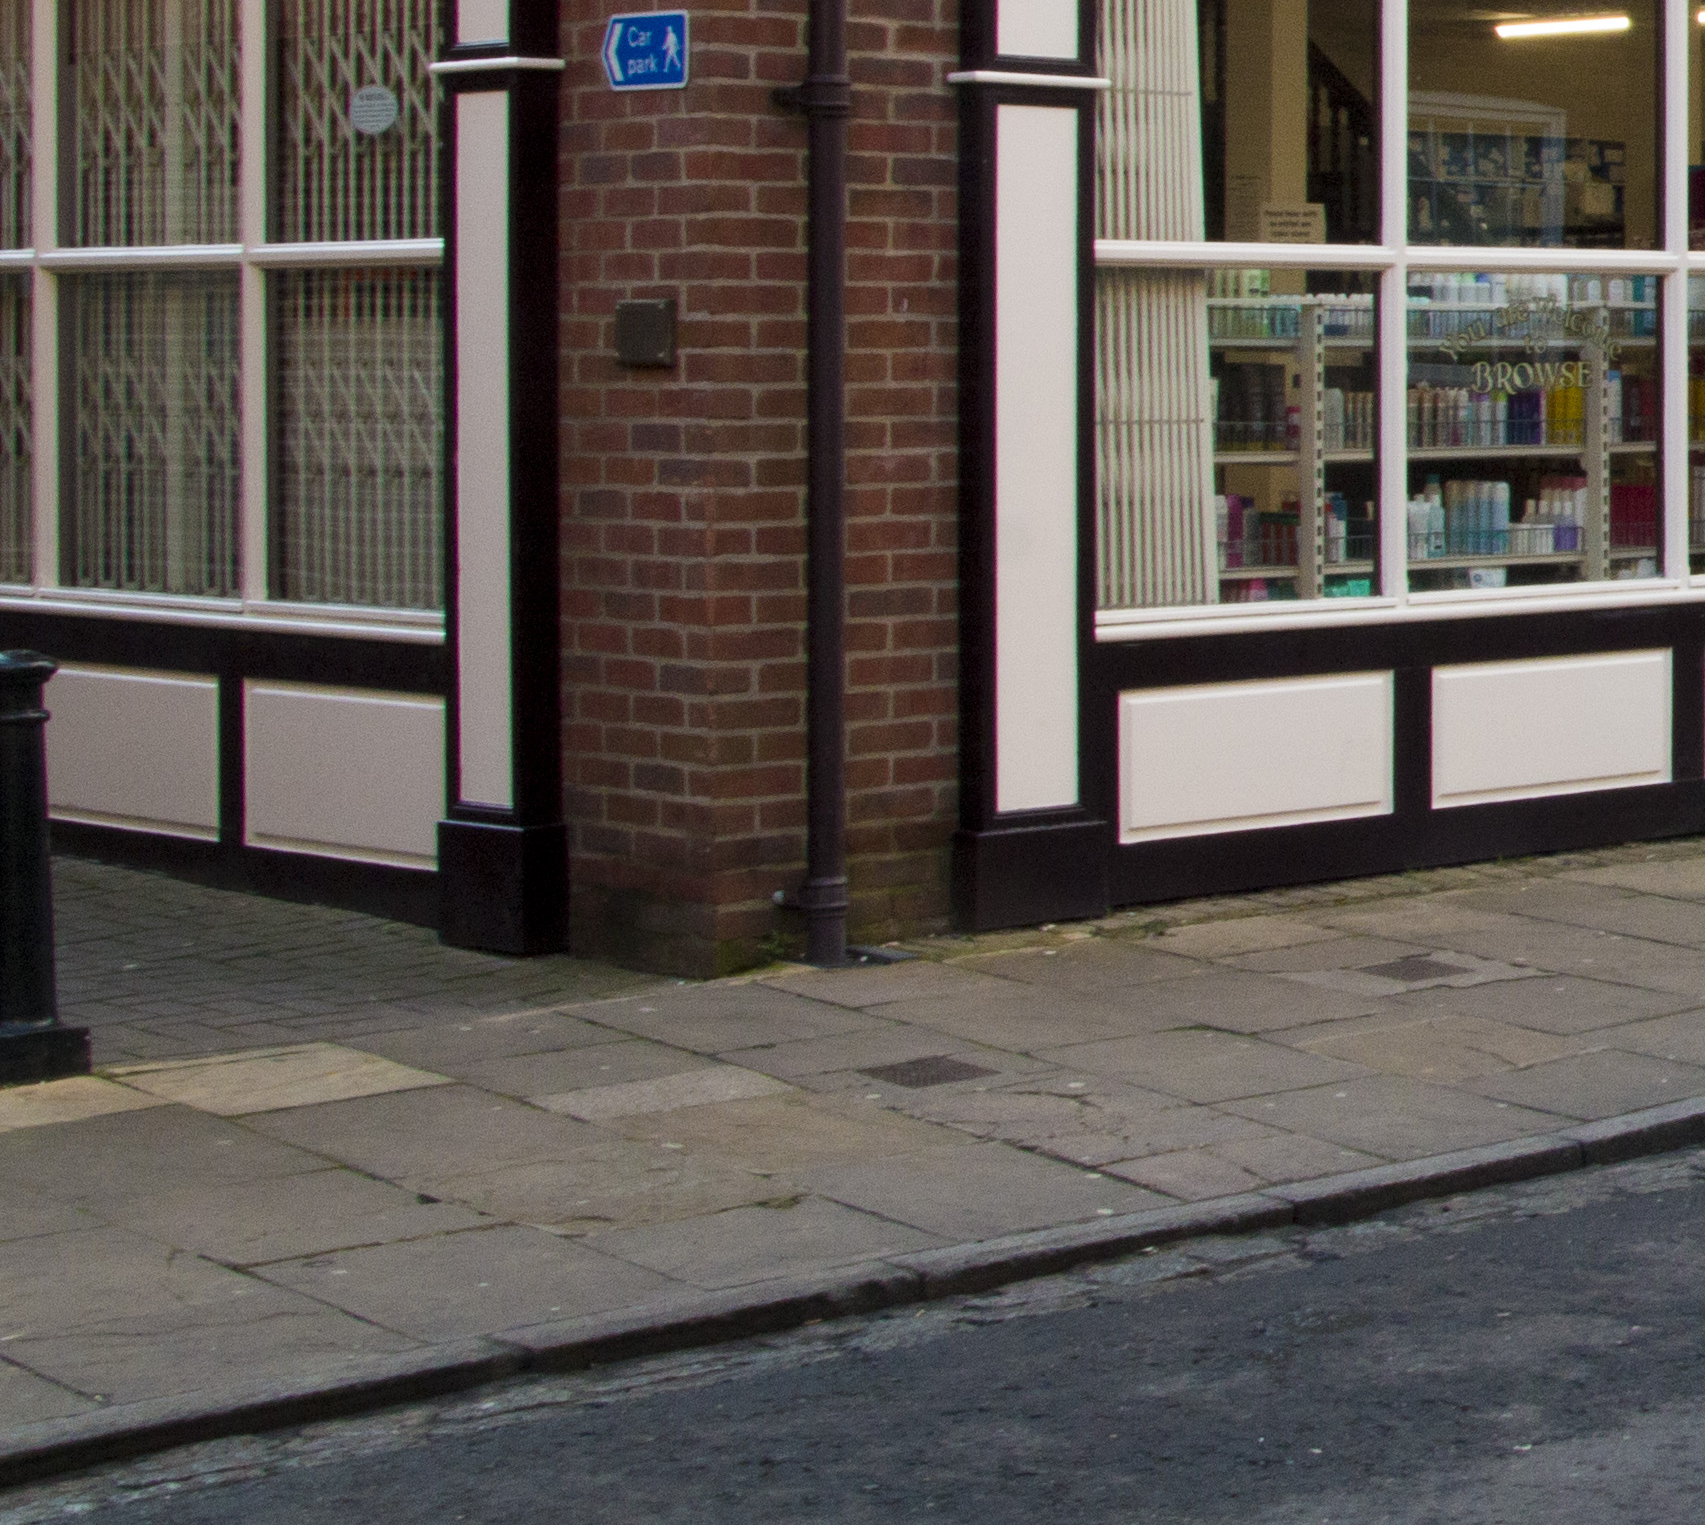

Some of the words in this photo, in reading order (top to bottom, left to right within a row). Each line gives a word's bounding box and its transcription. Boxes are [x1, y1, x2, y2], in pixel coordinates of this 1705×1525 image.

[627, 25, 652, 48] Car
[627, 54, 658, 77] park
[1471, 360, 1592, 396] BROWSE
